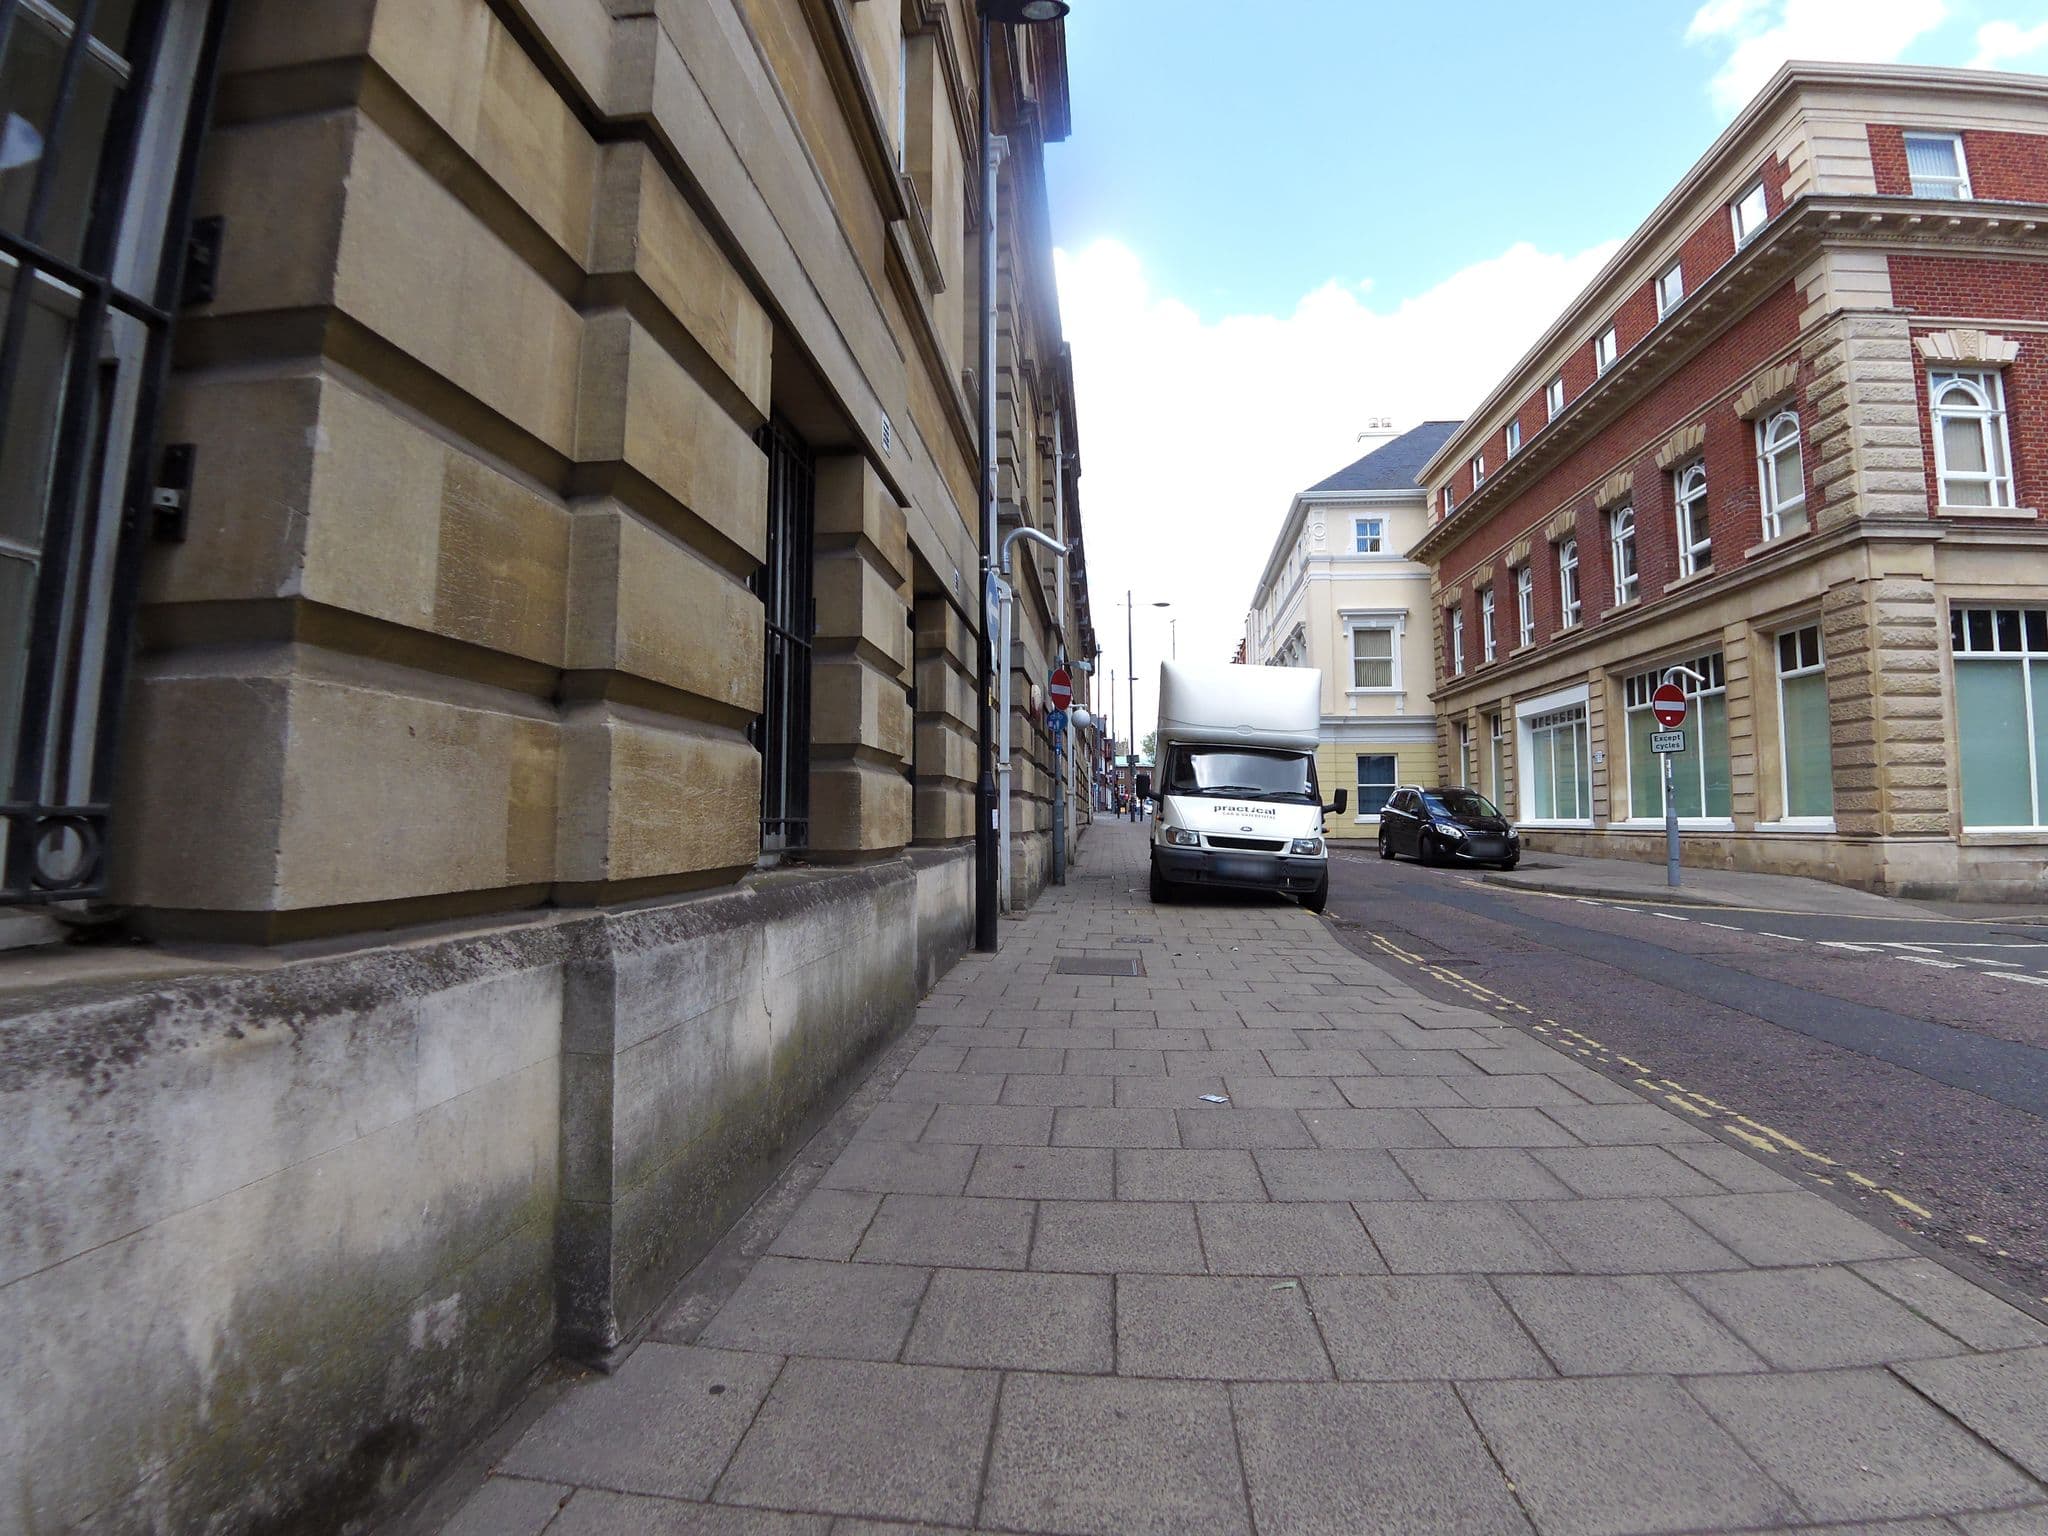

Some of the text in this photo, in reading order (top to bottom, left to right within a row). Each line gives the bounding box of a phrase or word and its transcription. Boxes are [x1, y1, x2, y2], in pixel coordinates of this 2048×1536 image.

[1654, 734, 1681, 742] Except
[1655, 742, 1681, 750] cycles
[1214, 805, 1276, 815] practical
